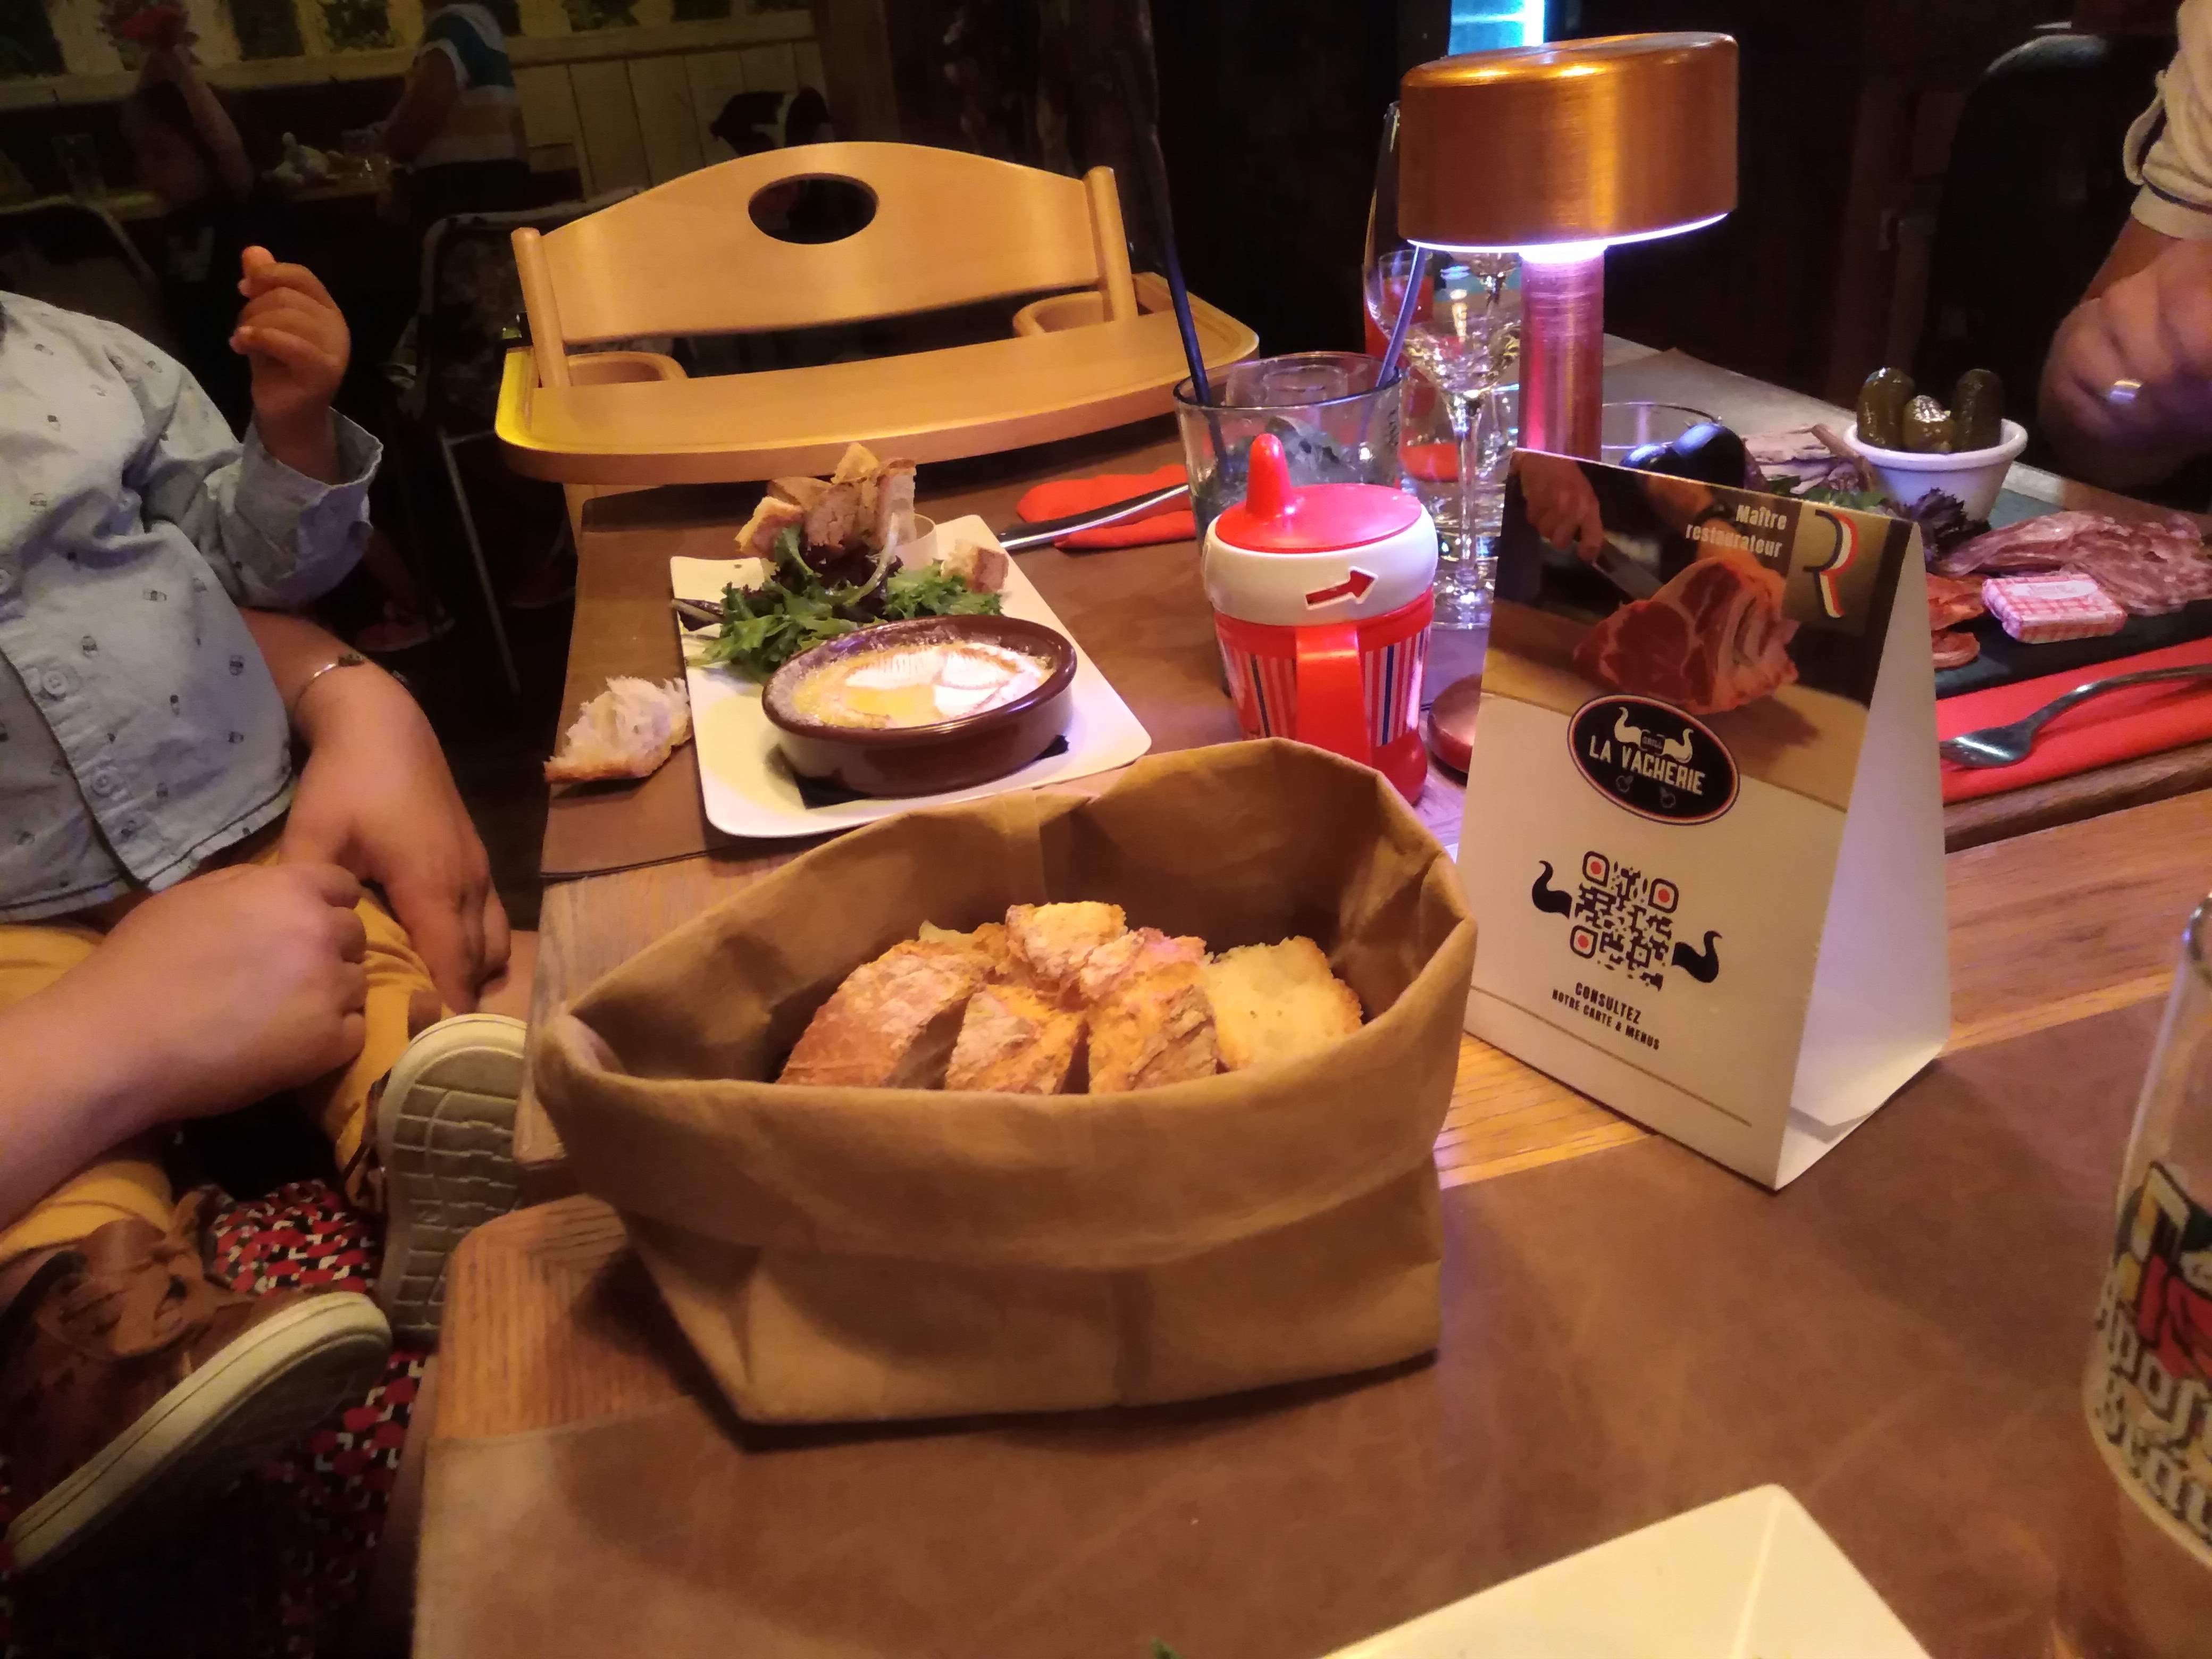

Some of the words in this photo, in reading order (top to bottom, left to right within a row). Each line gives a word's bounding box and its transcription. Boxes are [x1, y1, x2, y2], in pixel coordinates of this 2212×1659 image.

[1736, 504, 1787, 530] Maître
[1685, 523, 1782, 558] restaurateur
[1589, 734, 1612, 764] LA
[1621, 745, 1706, 796] VACHERIE
[1552, 988, 1581, 1011] NOTRE
[1583, 1004, 1613, 1027] CARTE
[1615, 1020, 1622, 1032] &
[1625, 1024, 1660, 1050] MENUS
[1575, 982, 1641, 1025] CONSULTEZ
